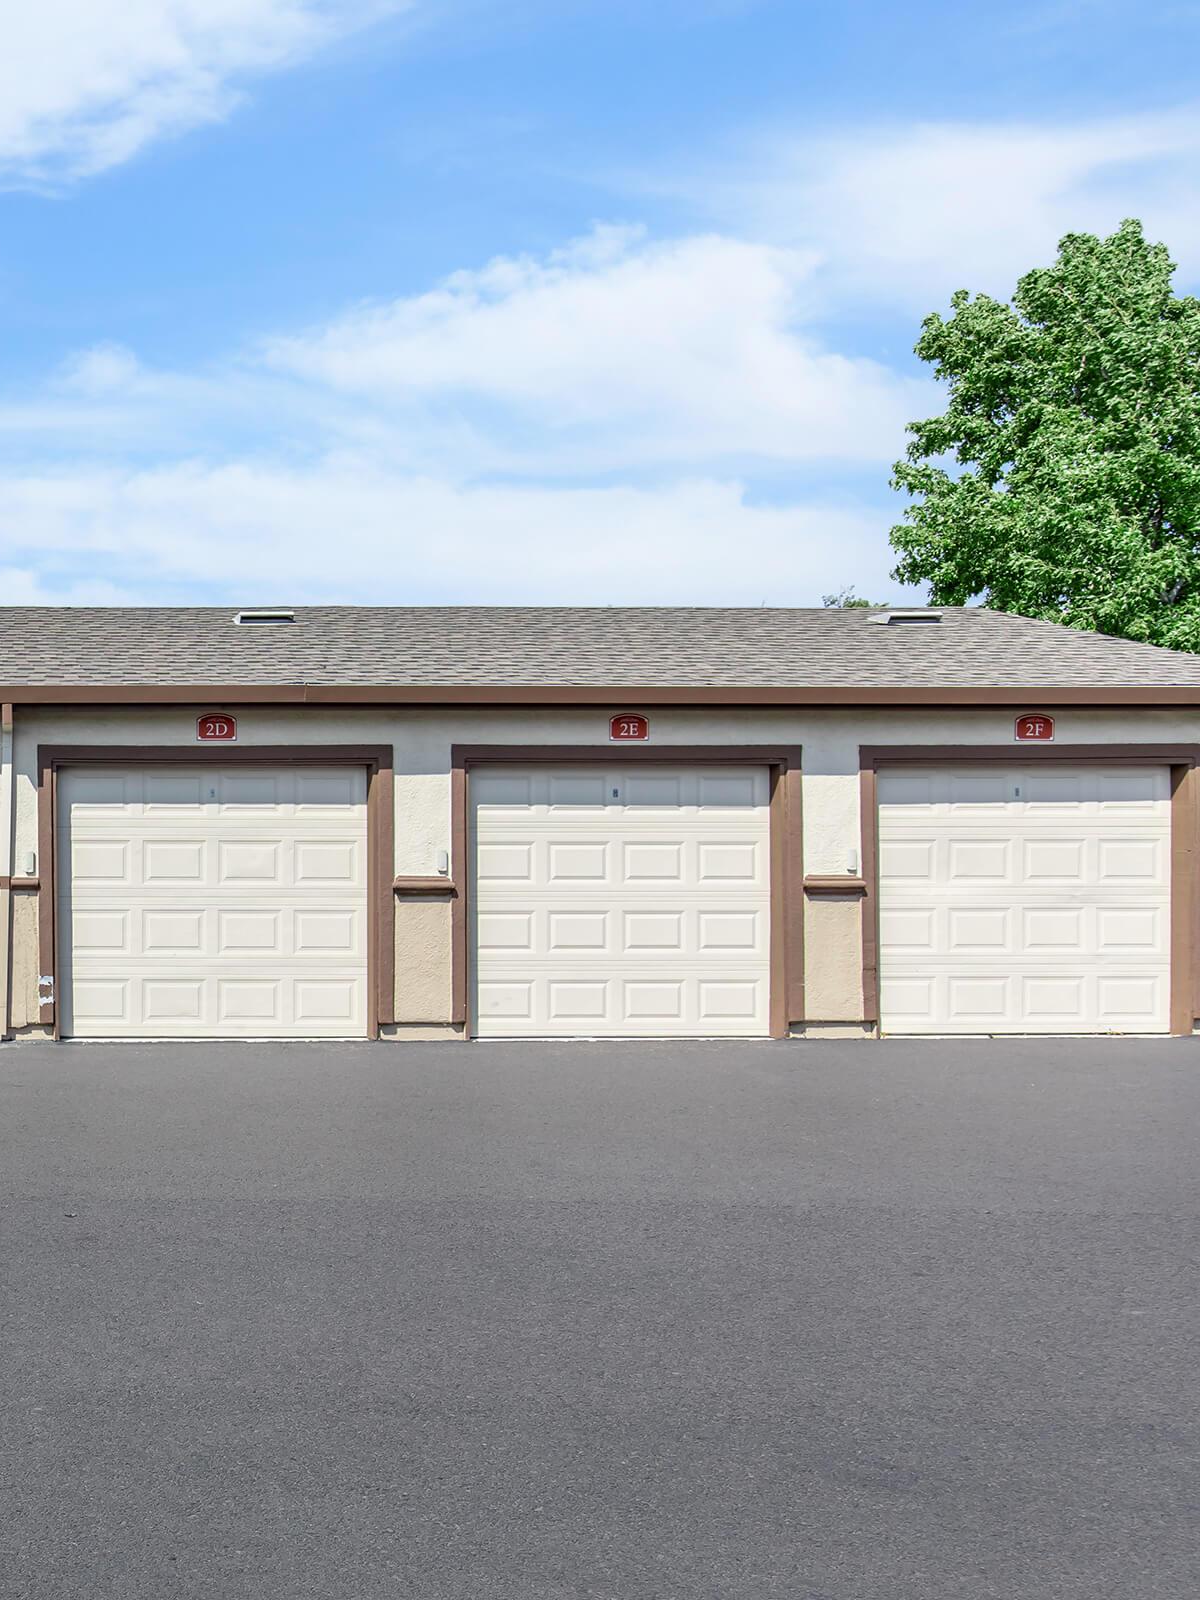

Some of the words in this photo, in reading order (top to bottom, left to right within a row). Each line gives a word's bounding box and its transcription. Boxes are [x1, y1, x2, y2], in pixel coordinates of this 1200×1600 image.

[206, 723, 228, 736] 2D
[619, 723, 639, 736] 2E
[1025, 723, 1044, 736] 2F
